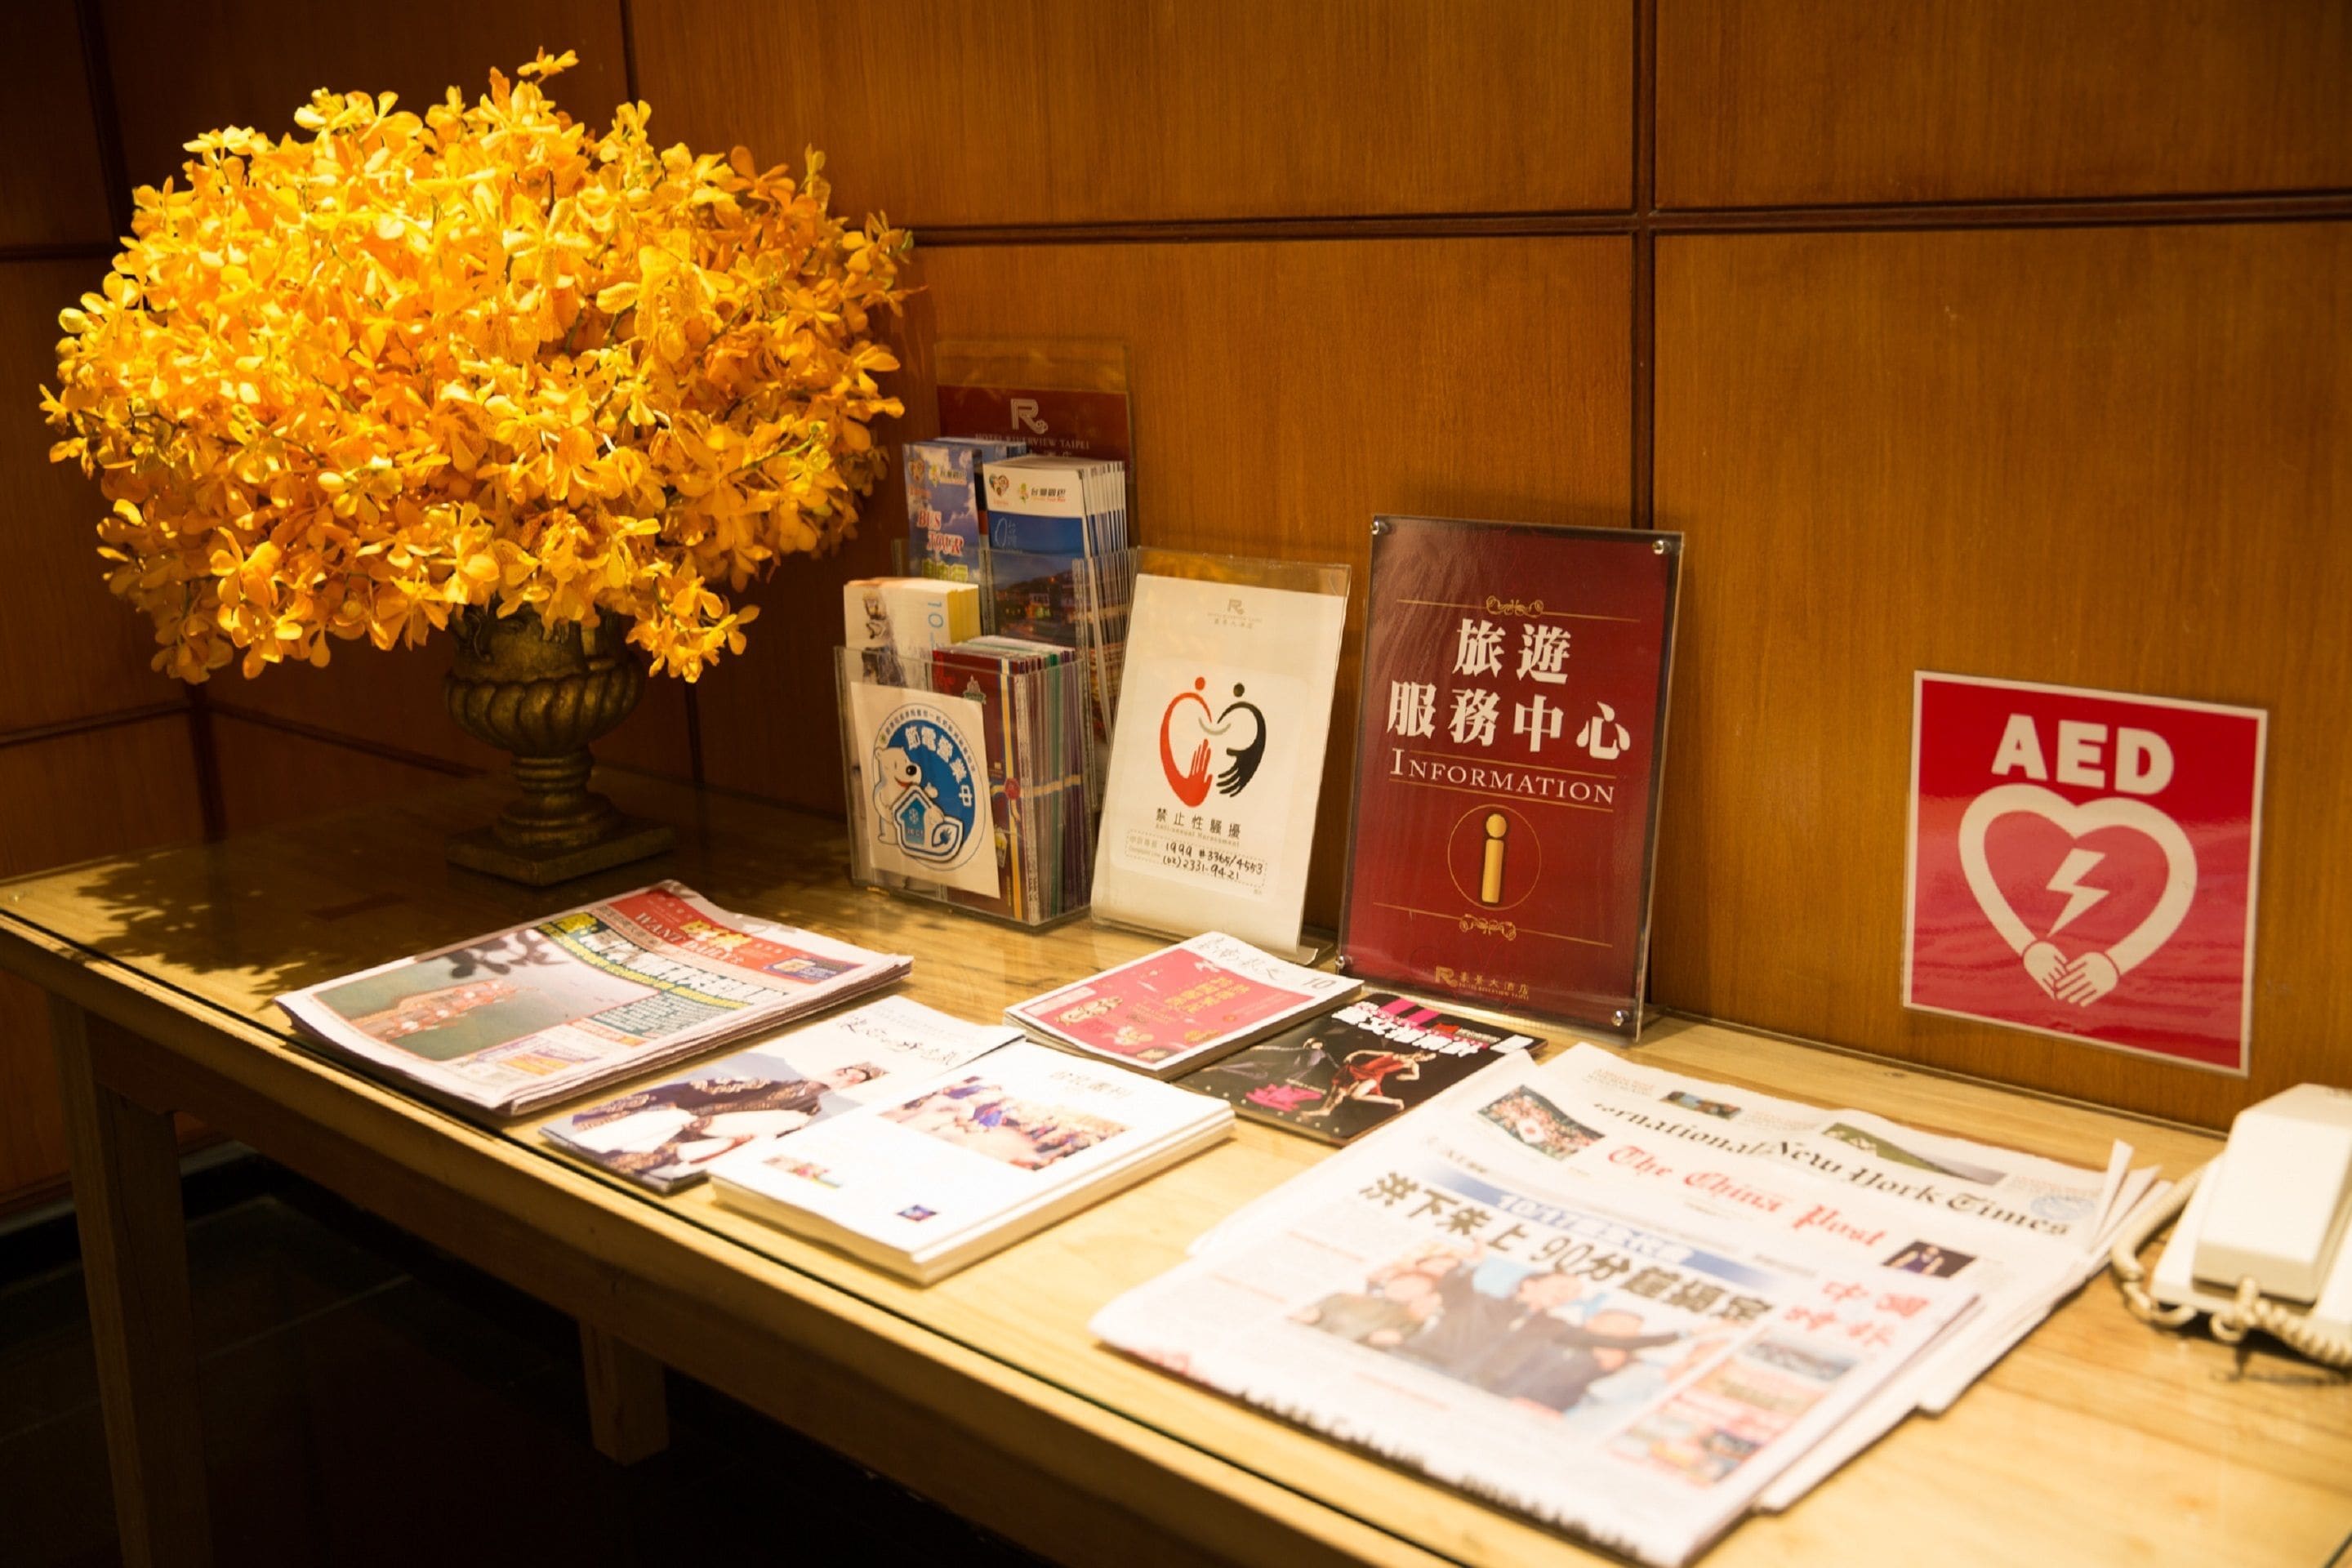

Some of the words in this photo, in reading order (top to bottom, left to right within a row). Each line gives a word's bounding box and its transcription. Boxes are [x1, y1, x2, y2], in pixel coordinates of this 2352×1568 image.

[1452, 617, 1572, 686] 旅遊
[1387, 679, 1632, 762] 服務中心
[1990, 713, 2175, 796] AED
[1389, 747, 1616, 805] INFORMATION
[1155, 807, 1241, 840] 禁止性騷擾
[1165, 841, 1193, 858] 1999
[635, 911, 684, 943] WANT
[1608, 1145, 1673, 1177] The
[1684, 1172, 1783, 1214] China
[1792, 1204, 1887, 1246] Post
[1758, 1140, 1842, 1174] New
[1849, 1167, 1941, 1205] York
[1947, 1192, 2071, 1236] Times
